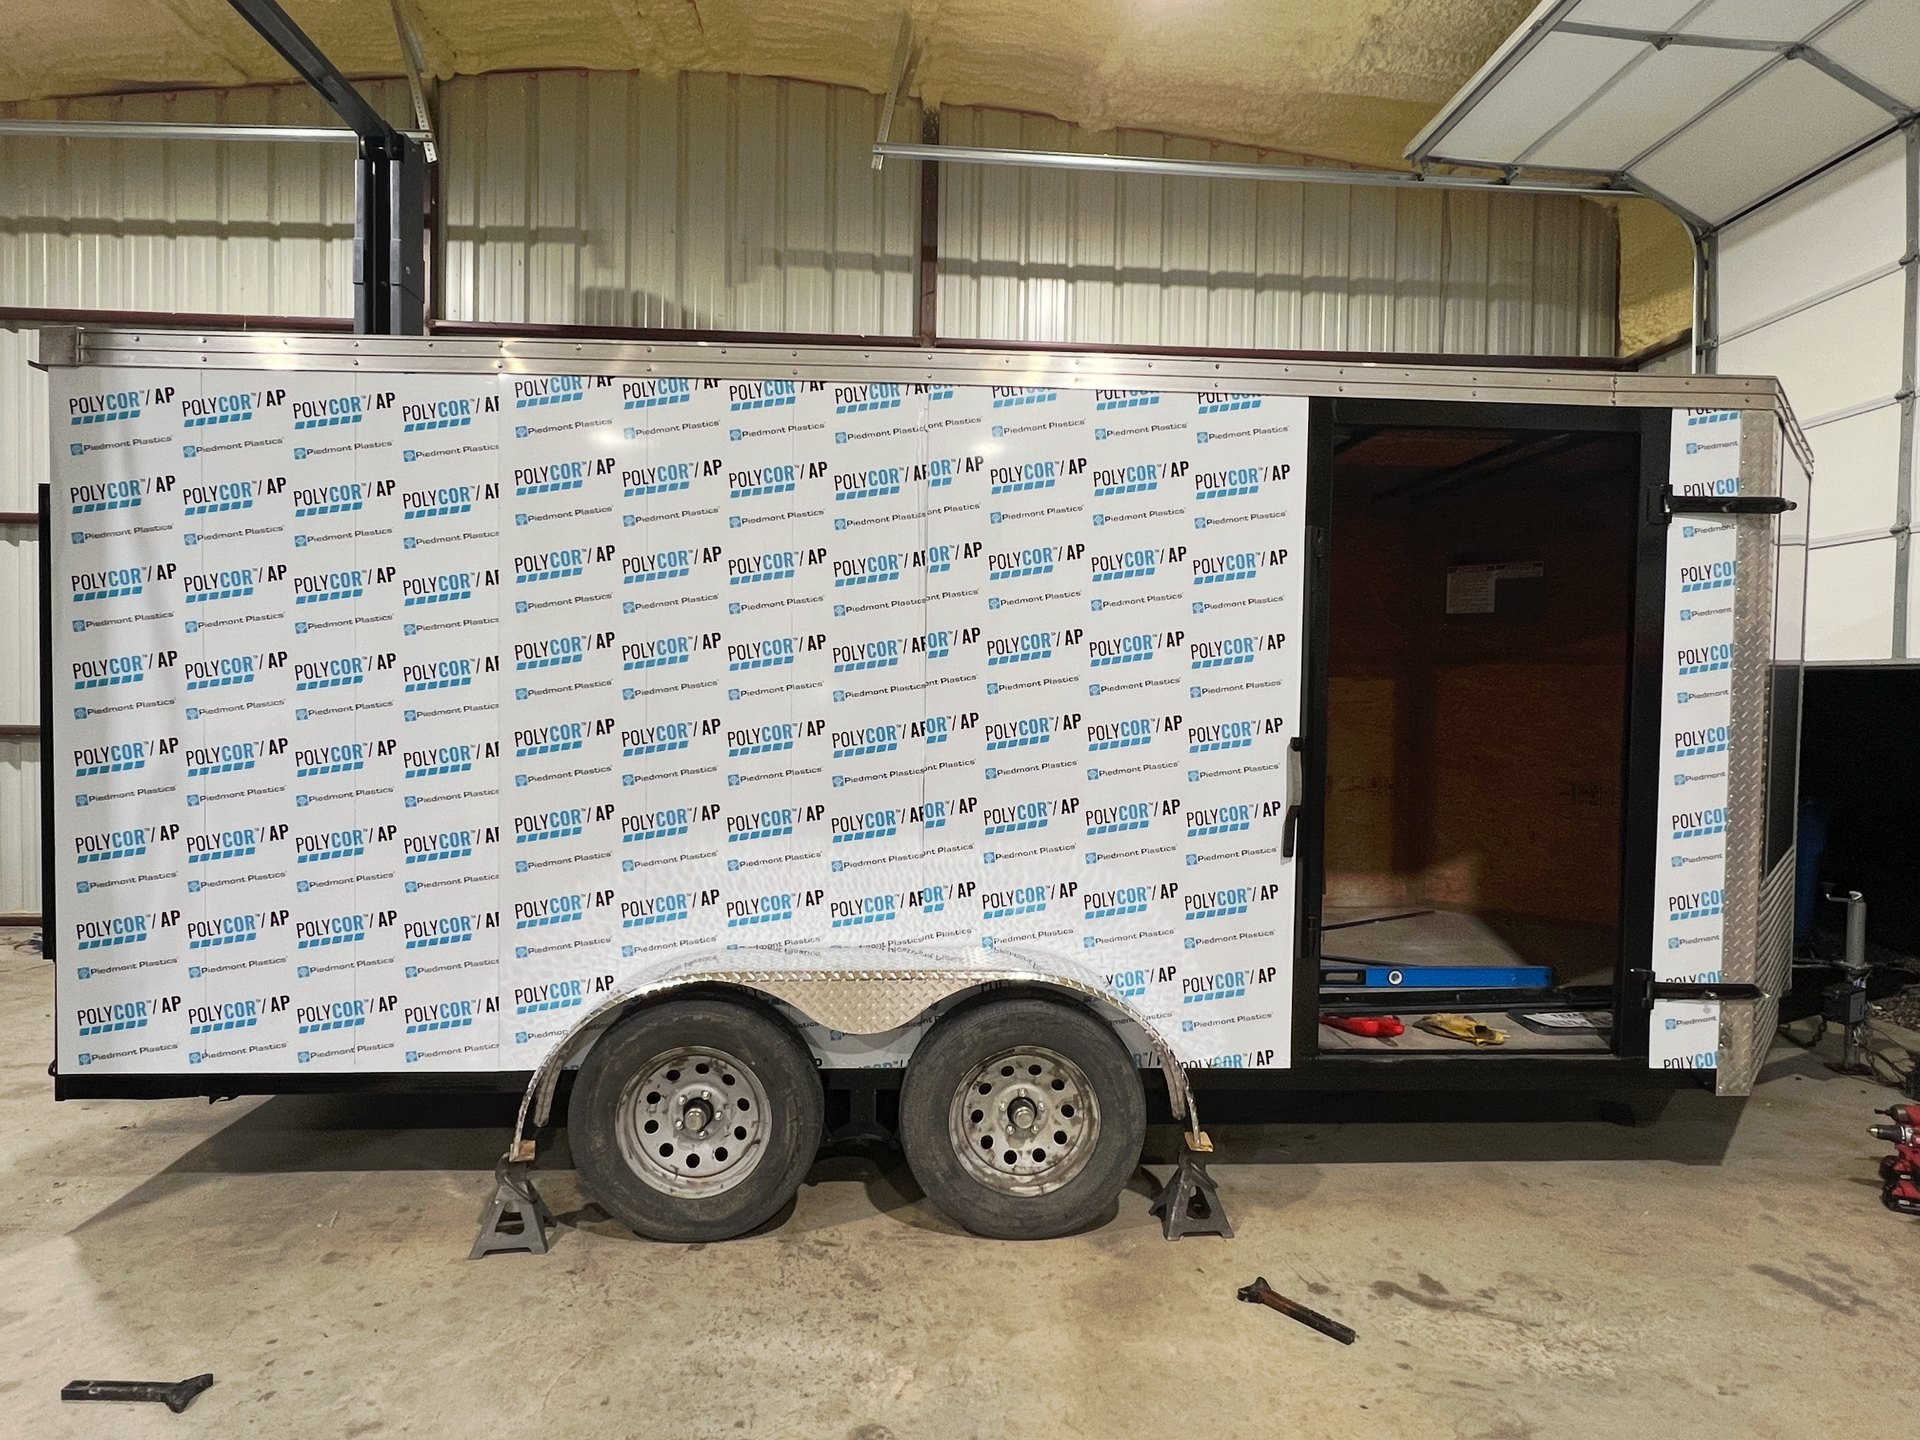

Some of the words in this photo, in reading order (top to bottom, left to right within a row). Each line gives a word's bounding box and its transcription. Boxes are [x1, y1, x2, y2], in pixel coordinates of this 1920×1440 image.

[155, 387, 174, 404] AP
[376, 392, 395, 409] AP
[635, 427, 680, 437] Piedmont
[682, 421, 719, 431] Plastics
[84, 441, 131, 452] Piedmont
[133, 435, 173, 445] Plastics
[306, 445, 352, 457] Piedmont
[354, 440, 393, 449] Plastics
[1697, 441, 1738, 451] Piedmont
[597, 458, 616, 475] AP
[809, 462, 827, 479] AP
[1171, 461, 1189, 478] AP
[267, 477, 286, 494] AP
[528, 512, 573, 523] Piedmont
[575, 506, 613, 516] Plastics
[740, 515, 785, 526] Piedmont
[787, 509, 824, 519] Plastics
[1104, 513, 1147, 525] Piedmont
[1149, 507, 1185, 517] Plastics
[196, 531, 243, 543] Piedmont
[245, 525, 284, 535] Plastics
[1694, 524, 1735, 534] Piedmont
[703, 547, 721, 564] AP
[1067, 544, 1085, 561] AP
[1270, 549, 1287, 566] AP
[157, 563, 176, 580] AP
[634, 600, 679, 611] Piedmont
[681, 594, 719, 604] Plastics
[999, 596, 1043, 608] Piedmont
[1045, 590, 1081, 600] Plastics
[1203, 601, 1246, 612] Piedmont
[1248, 595, 1284, 605] Plastics
[86, 617, 133, 629] Piedmont
[135, 611, 174, 621] Plastics
[1691, 607, 1732, 617] Piedmont
[416, 621, 462, 633] Piedmont
[597, 632, 616, 649] AP
[807, 634, 826, 651] AP
[378, 653, 396, 670] AP
[528, 685, 573, 697] Piedmont
[575, 679, 613, 689] Plastics
[739, 687, 784, 698] Piedmont
[786, 680, 823, 691] Plastics
[1688, 690, 1729, 700] Piedmont
[307, 706, 354, 718] Piedmont
[356, 700, 394, 710] Plastics
[702, 719, 721, 736] AP
[1063, 714, 1081, 731] AP
[1265, 717, 1283, 734] AP
[269, 738, 288, 755] AP
[634, 772, 679, 783] Piedmont
[680, 765, 718, 776] Plastics
[996, 766, 1039, 778] Piedmont
[1041, 760, 1078, 770] Plastics
[1199, 769, 1242, 781] Piedmont
[1244, 763, 1279, 773] Plastics
[1685, 771, 1726, 782] Piedmont
[199, 792, 245, 804] Piedmont
[247, 785, 286, 796] Plastics
[597, 804, 615, 821] AP
[806, 804, 824, 821] AP
[1163, 799, 1180, 816] AP
[160, 824, 179, 841] AP
[528, 857, 573, 869] Piedmont
[575, 851, 613, 861] Plastics
[738, 857, 783, 868] Piedmont
[784, 850, 821, 861] Plastics
[1096, 851, 1139, 863] Piedmont
[1141, 845, 1177, 855] Plastics
[1682, 854, 1723, 864] Piedmont
[89, 878, 136, 890] Piedmont
[138, 871, 177, 881] Plastics
[702, 889, 720, 906] AP
[1261, 884, 1278, 900] AP
[379, 910, 397, 927] AP
[634, 942, 678, 954] Piedmont
[680, 935, 717, 946] Plastics
[1195, 935, 1237, 947] Piedmont
[1239, 929, 1275, 939] Plastics
[1679, 935, 1720, 945] Piedmont
[309, 963, 355, 975] Piedmont
[357, 957, 395, 967] Plastics
[596, 974, 615, 991] AP
[271, 995, 290, 1013] AP
[1676, 1016, 1717, 1026] Piedmont
[201, 1049, 247, 1061] Piedmont
[249, 1042, 288, 1053] Plastics
